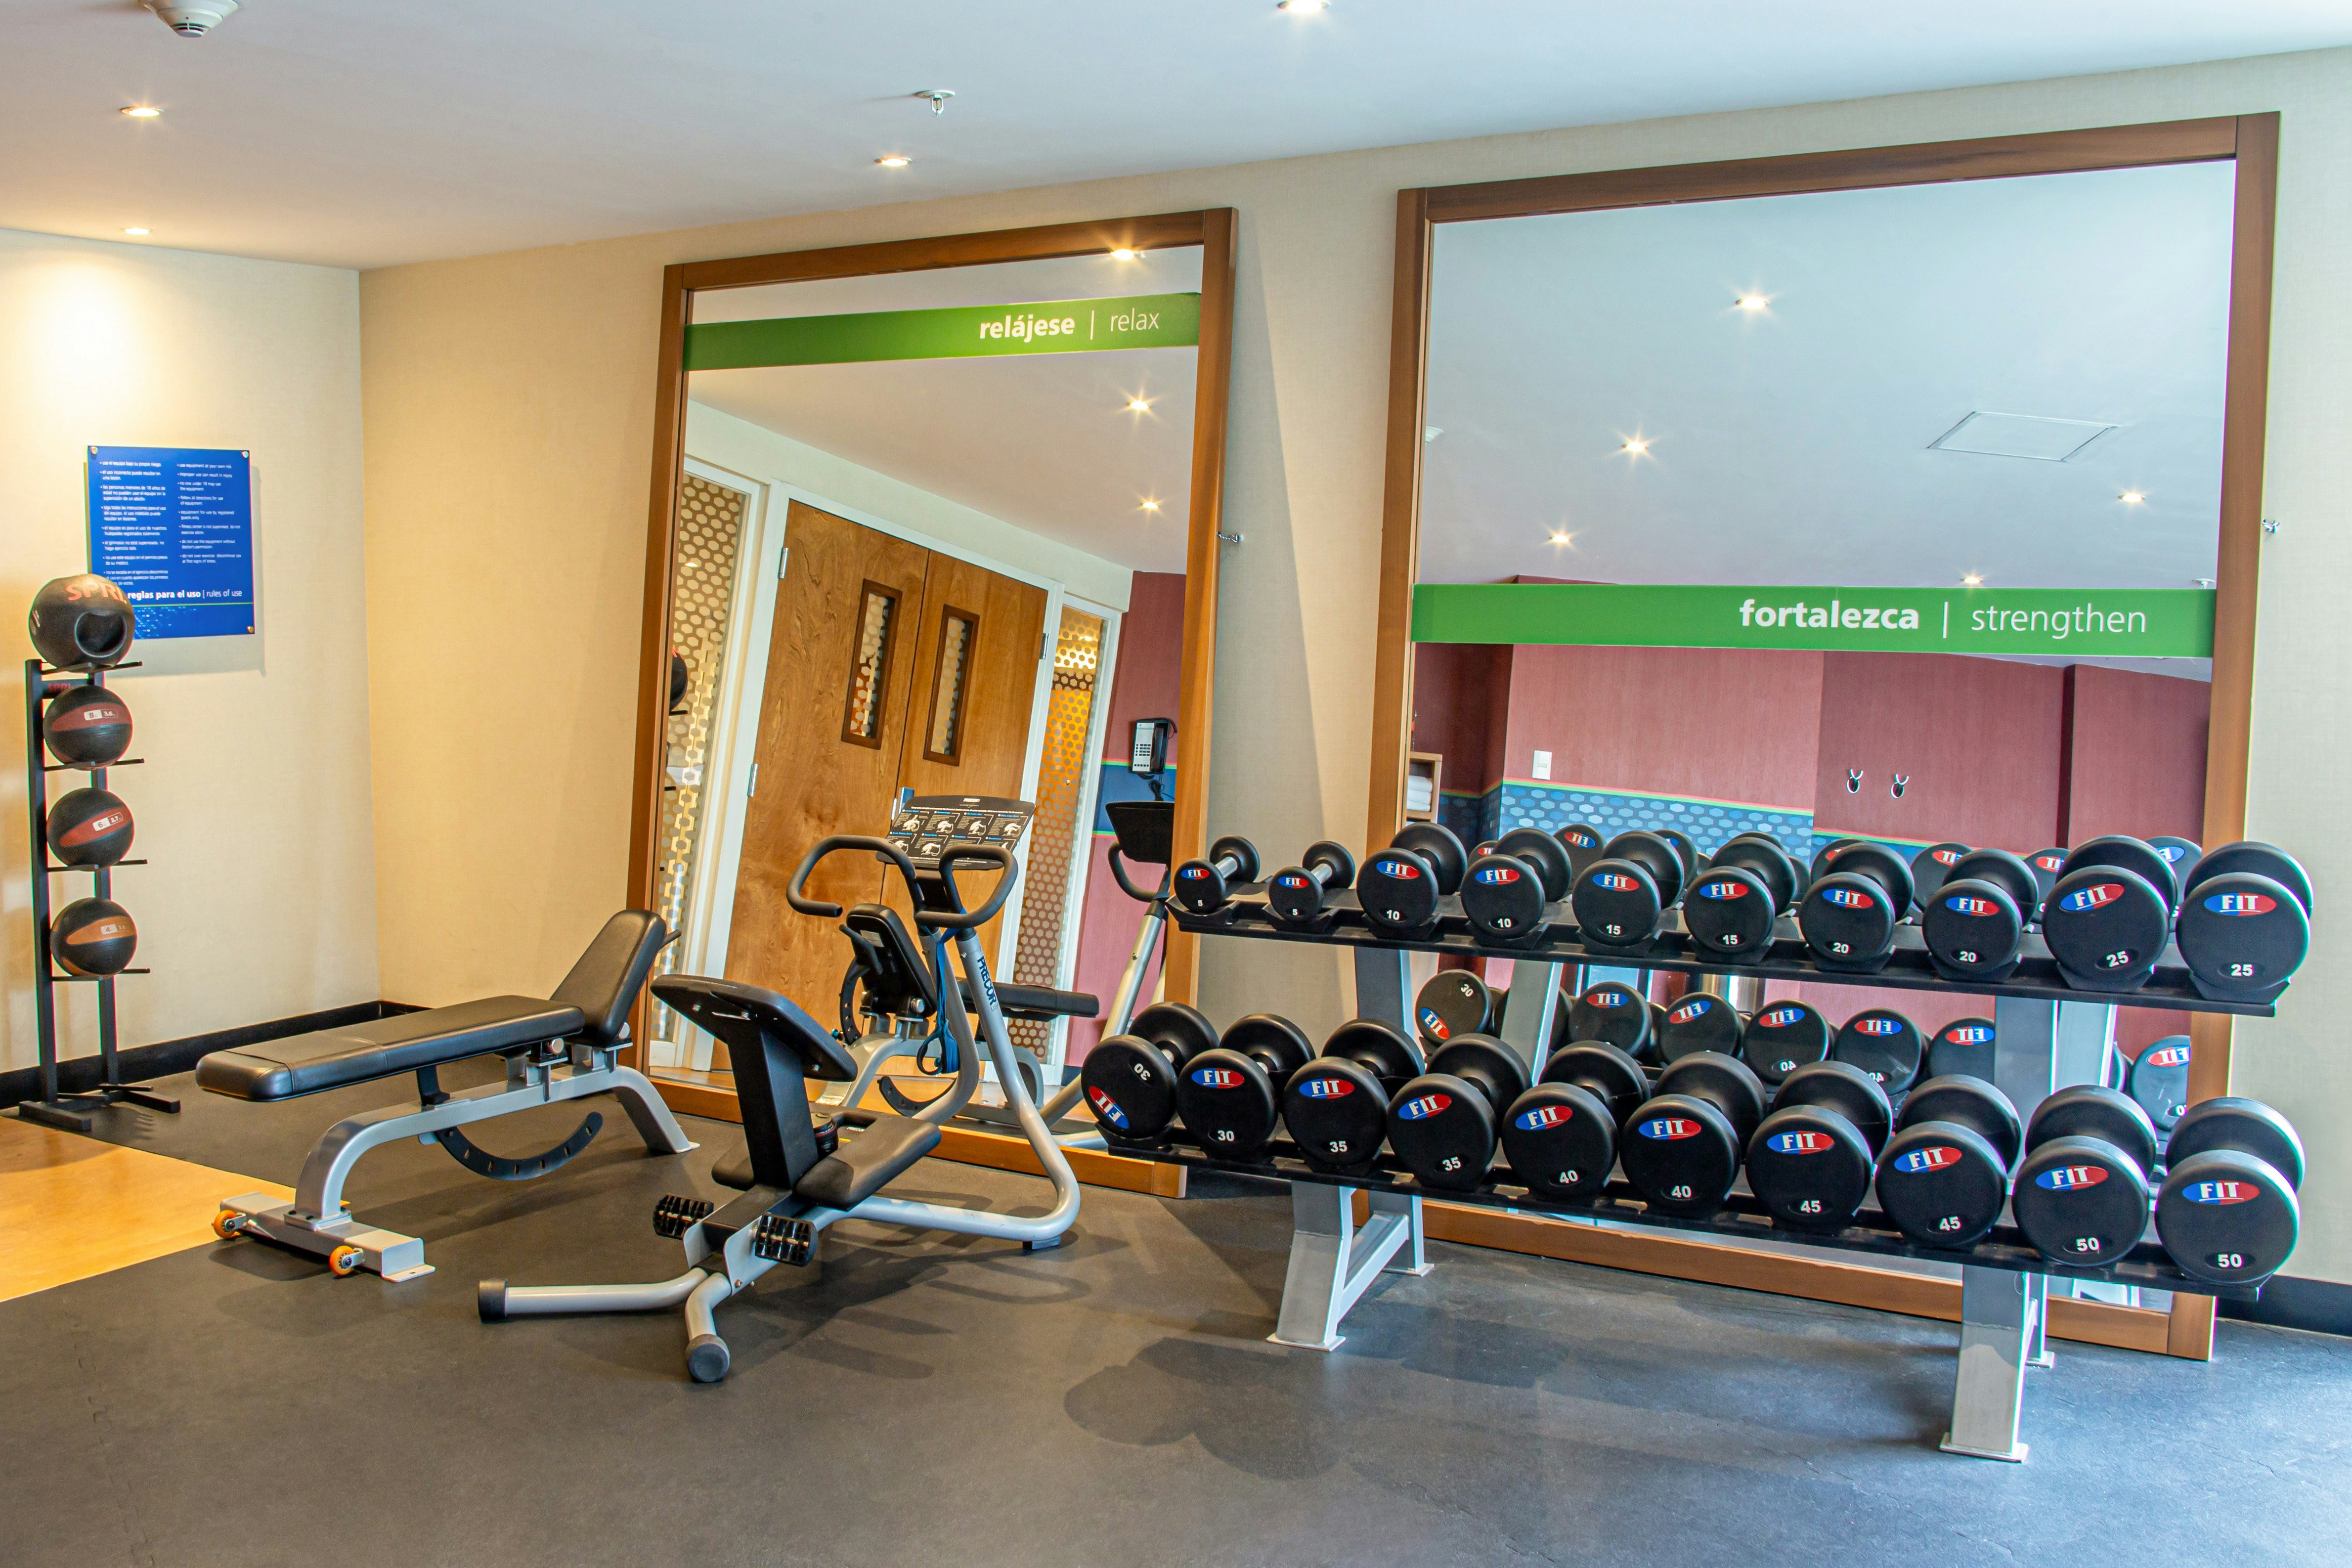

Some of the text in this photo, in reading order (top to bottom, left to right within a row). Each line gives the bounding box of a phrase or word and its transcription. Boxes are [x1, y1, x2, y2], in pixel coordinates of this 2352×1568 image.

[980, 307, 1160, 343] relájese relax
[128, 590, 154, 601] reglas
[156, 591, 175, 600] para
[177, 590, 185, 598] el
[223, 589, 230, 597] of
[1739, 599, 2146, 639] fortalezca strengthen
[1386, 862, 1410, 876] FIT
[1485, 869, 1508, 880] FIT
[1286, 877, 1301, 885] FIT
[1604, 874, 1628, 888] FIT
[1711, 883, 1736, 895] FIT
[1834, 890, 1861, 905] FIT
[2074, 886, 2108, 907] FIT
[2222, 895, 2259, 910] FIT
[1959, 898, 1986, 912] FIT
[1386, 910, 1400, 920] 10
[1497, 918, 1512, 928] 10
[1606, 924, 1621, 935] 15
[1722, 934, 1739, 946] 15
[1832, 942, 1851, 954] 20
[1959, 951, 1977, 963] 20
[2106, 951, 2130, 967] 25
[2230, 964, 2254, 976] 25
[977, 956, 997, 1006] PRECOR
[1133, 1063, 1151, 1081] 30
[1203, 1070, 1231, 1084] FIT
[1311, 1080, 1339, 1094] FIT
[1095, 1095, 1122, 1123] FIT
[1408, 1095, 1438, 1116] FIT
[1526, 1107, 1558, 1126] FIT
[1653, 1120, 1685, 1135] FIT
[1217, 1130, 1235, 1141] 30
[1782, 1133, 1816, 1149] FIT
[1329, 1140, 1348, 1153] 35
[1442, 1156, 1462, 1172] 35
[1908, 1148, 1944, 1168] FIT
[1559, 1170, 1579, 1184] 40
[2051, 1167, 2089, 1185] FIT
[1671, 1185, 1692, 1198] 40
[2200, 1182, 2239, 1198] FIT
[1800, 1199, 1822, 1214] 45
[1938, 1216, 1962, 1231] 45
[2076, 1237, 2100, 1252] 50
[2218, 1254, 2243, 1268] 50
